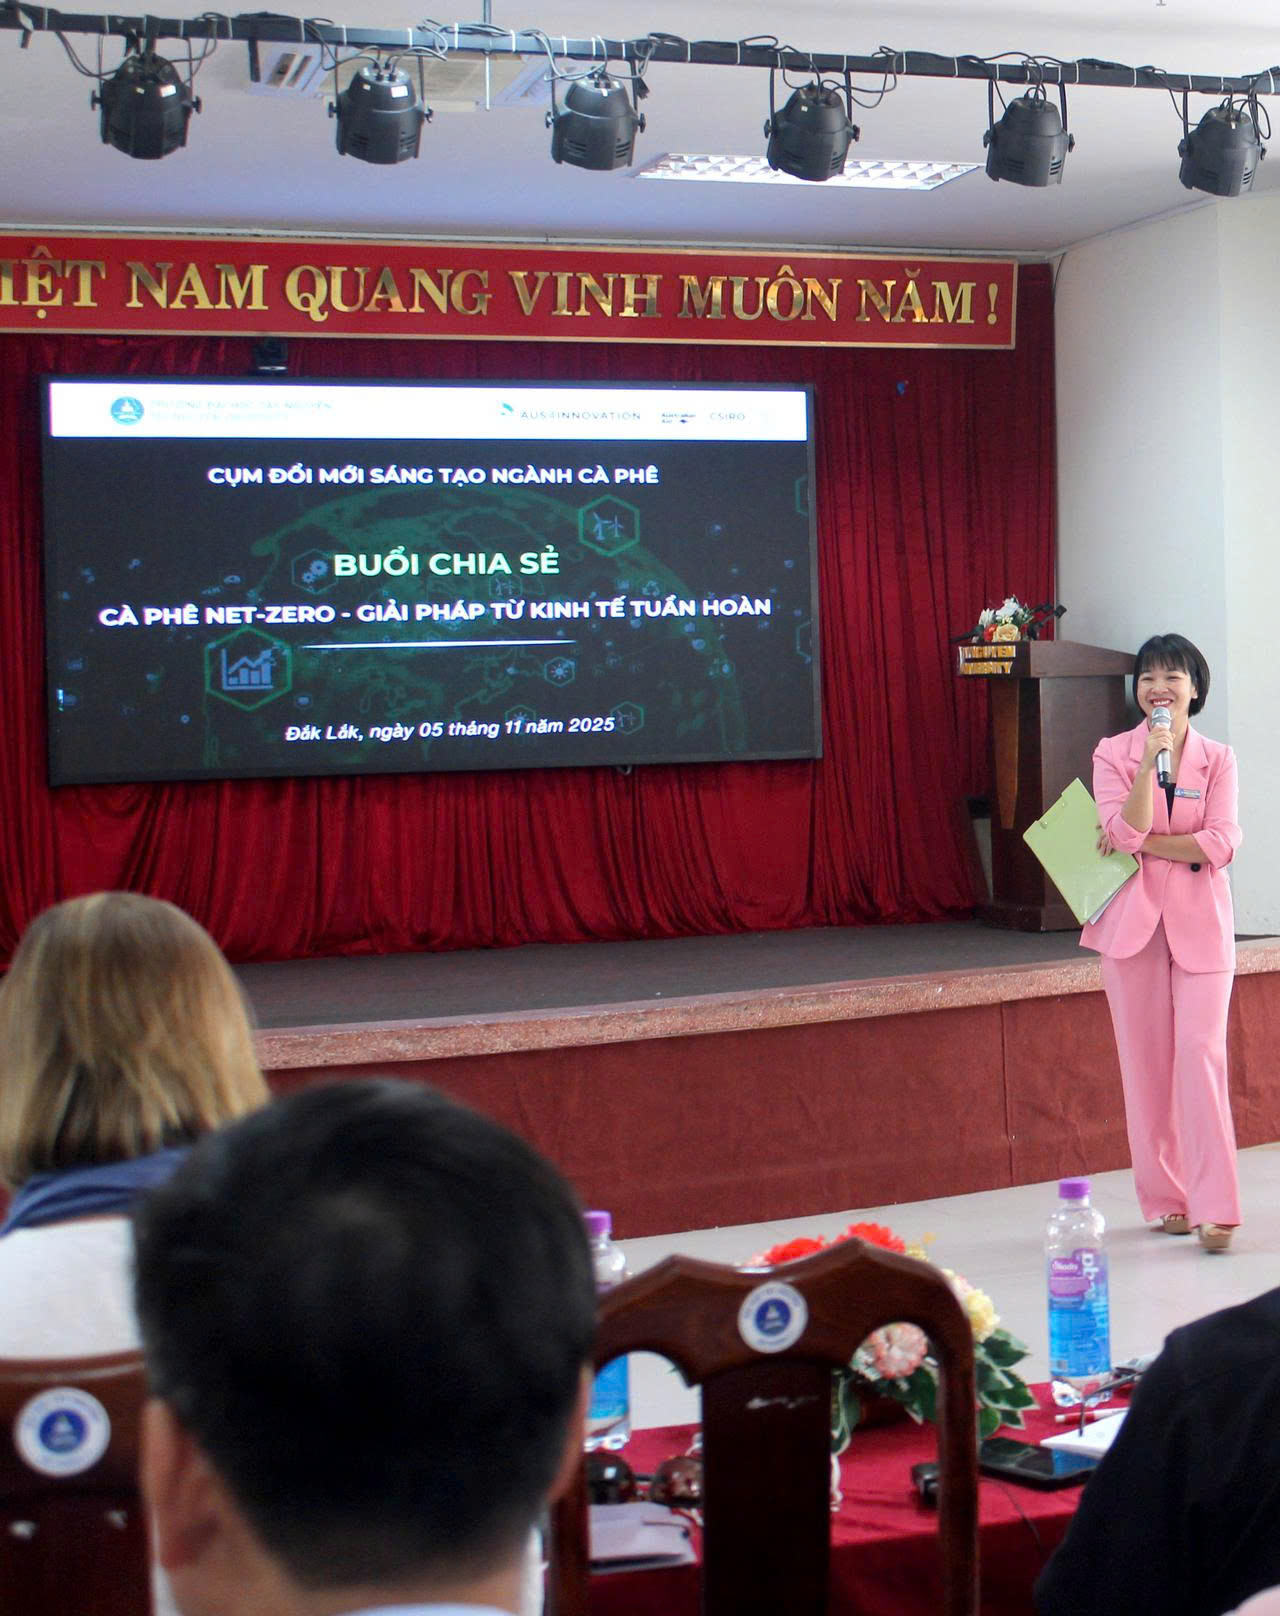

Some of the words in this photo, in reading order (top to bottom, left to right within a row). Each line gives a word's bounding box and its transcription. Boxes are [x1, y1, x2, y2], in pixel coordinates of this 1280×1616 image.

[0, 245, 106, 320] IỆT
[125, 262, 269, 311] NAM
[284, 264, 493, 323] QUANG
[508, 270, 664, 319] VINH
[677, 264, 842, 322] MUÔN
[709, 411, 747, 421] CSIRO
[207, 467, 263, 488] CỤM
[268, 462, 313, 484] ĐỔI
[319, 464, 365, 484] MỚI
[370, 464, 434, 484] SÁNG
[439, 468, 486, 488] TẠO
[491, 464, 573, 484] NGÀNH
[578, 464, 610, 484] CÀ
[614, 464, 659, 484] PHÊ
[334, 545, 419, 577] BUỔI
[428, 552, 512, 576] CHIA
[519, 544, 560, 575] SẺ
[99, 604, 139, 627] CÀ
[144, 603, 199, 626] PHÊ
[205, 605, 336, 625] NET-ZERO
[356, 598, 409, 622] GIẢI
[415, 599, 486, 621] PHÁP
[490, 598, 526, 620] TỪ
[531, 601, 590, 619] KINH
[595, 595, 626, 618] TẾ
[630, 594, 696, 618] TUẦN
[702, 595, 771, 616] HOÀN
[369, 722, 415, 742] ngày
[419, 722, 444, 738] 05
[448, 720, 500, 739] tháng
[505, 719, 522, 734] 11
[525, 718, 564, 734] năm
[568, 716, 615, 733] 2025
